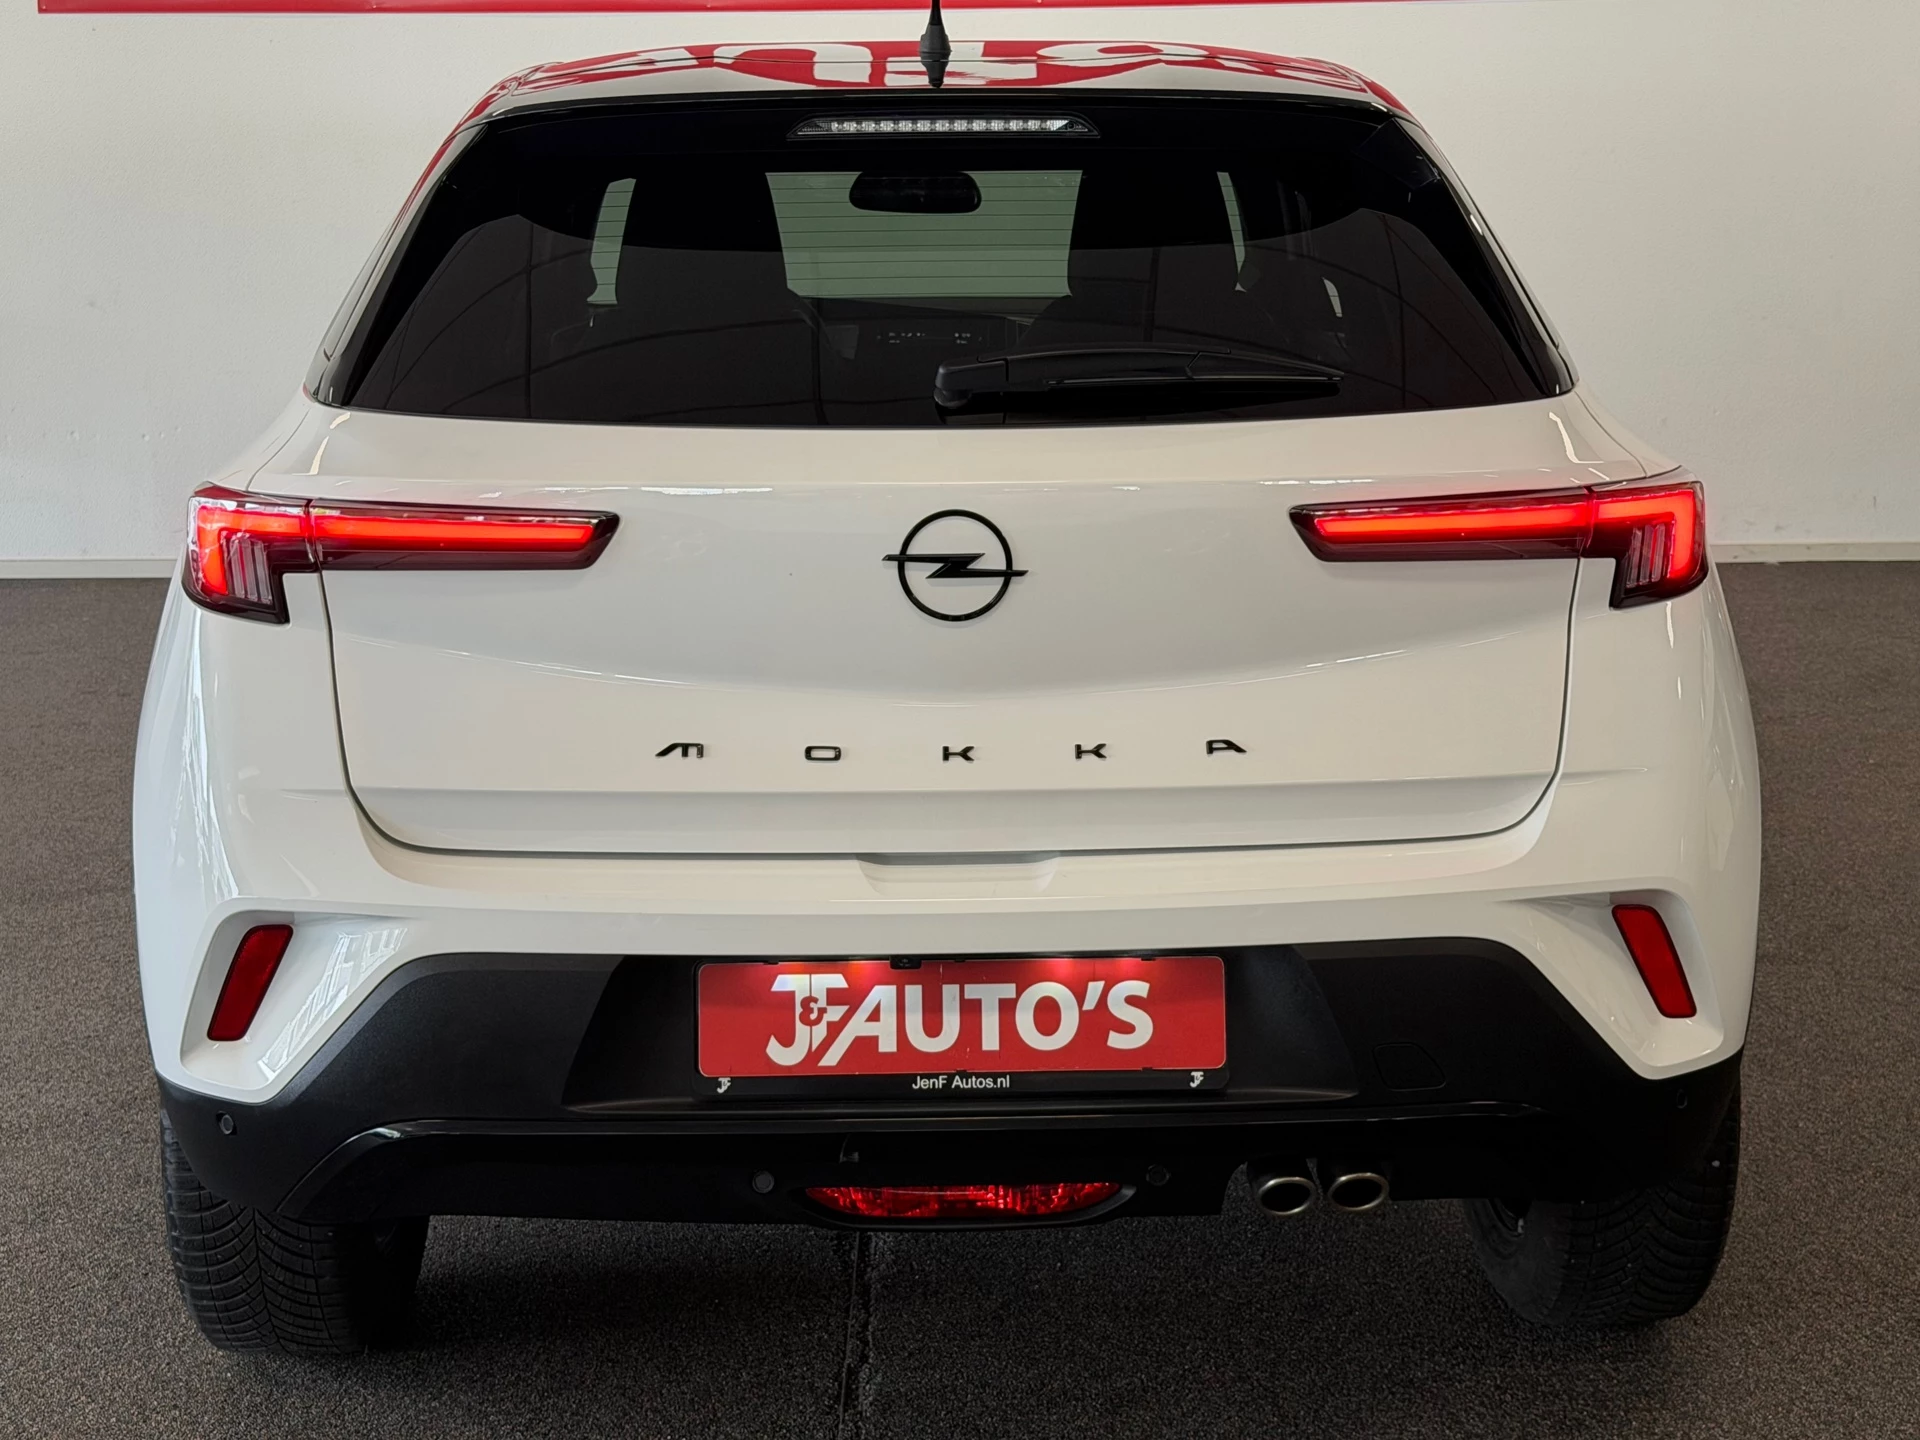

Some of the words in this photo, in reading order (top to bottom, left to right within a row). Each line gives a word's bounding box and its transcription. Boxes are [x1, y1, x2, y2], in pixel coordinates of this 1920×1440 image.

[655, 738, 1248, 763] MOKKA
[912, 1075, 948, 1089] JenF
[951, 1074, 1011, 1089] Autos.nl
